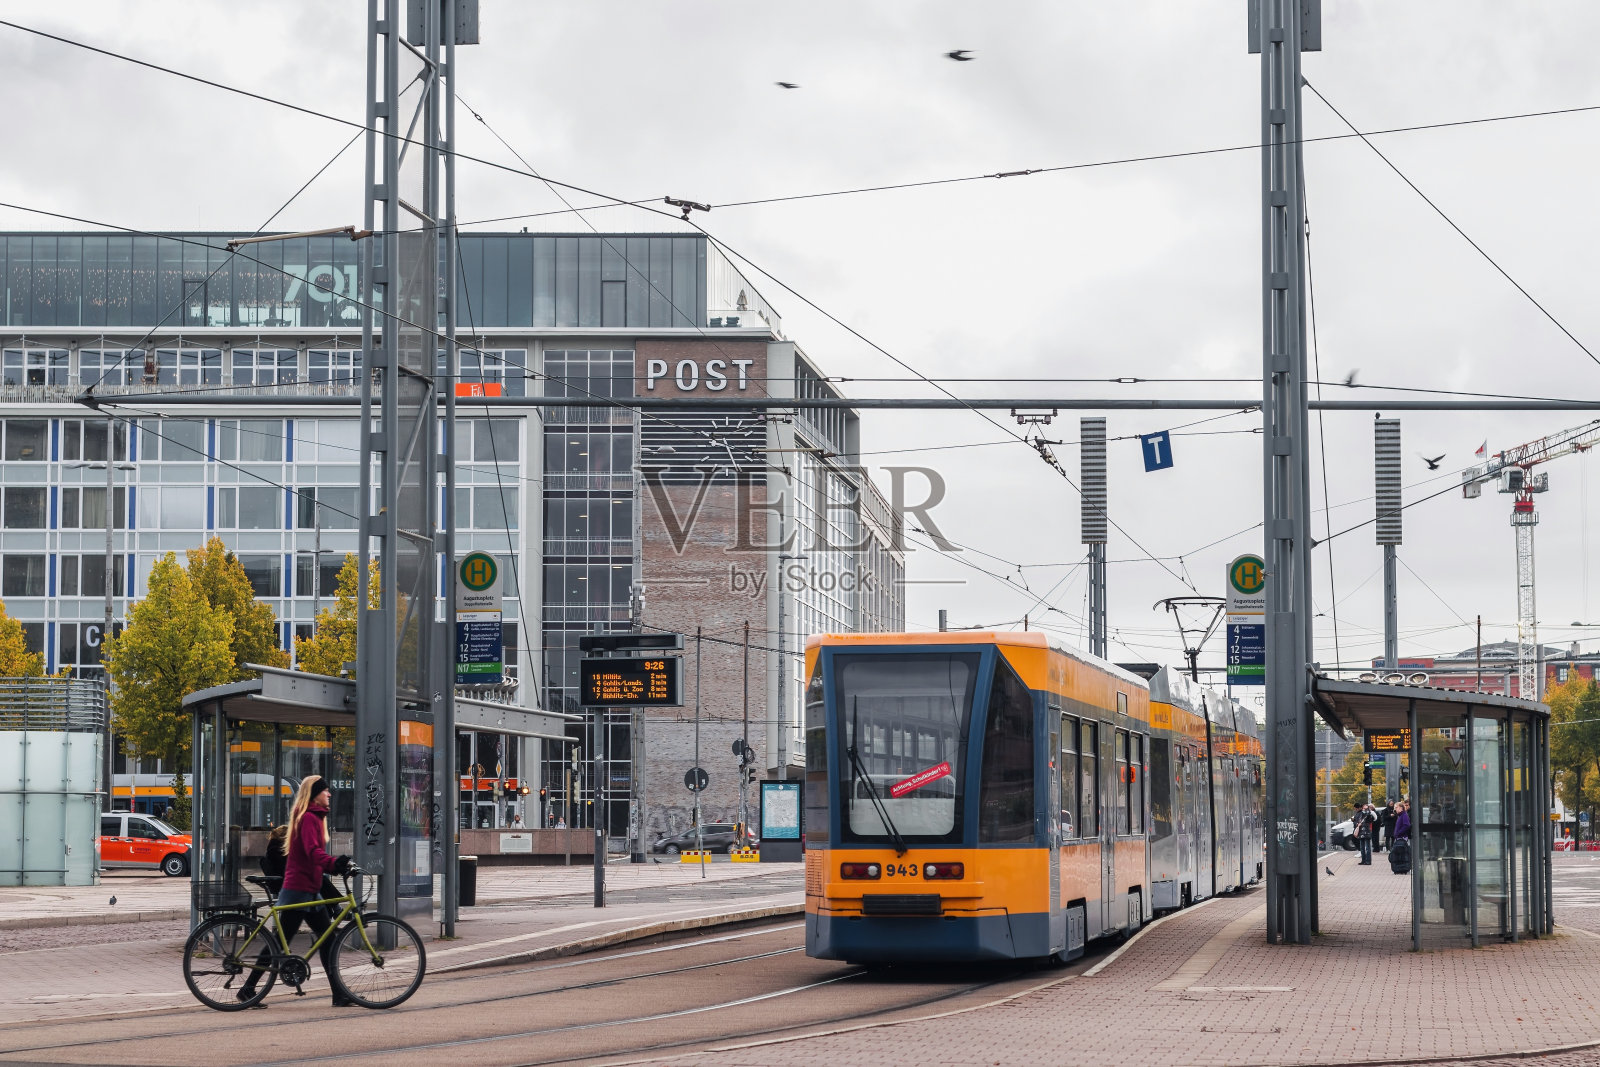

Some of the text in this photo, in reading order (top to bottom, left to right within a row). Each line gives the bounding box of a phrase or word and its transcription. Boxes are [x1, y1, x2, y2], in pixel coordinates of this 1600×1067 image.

[647, 359, 753, 391] POST
[1147, 435, 1164, 465] T
[471, 561, 487, 583] H
[1241, 565, 1257, 586] H
[463, 623, 469, 631] 4
[1233, 625, 1240, 634] 4
[463, 633, 469, 642] 7
[1234, 635, 1240, 644] 7
[459, 643, 469, 653] 12
[1230, 645, 1240, 654] 12
[459, 653, 469, 663] 15
[1229, 655, 1240, 664] 15
[457, 664, 470, 673] N17
[644, 661, 665, 670] 9:26
[1228, 665, 1241, 675] N17
[332, 780, 355, 789] REE
[886, 864, 918, 877] 943
